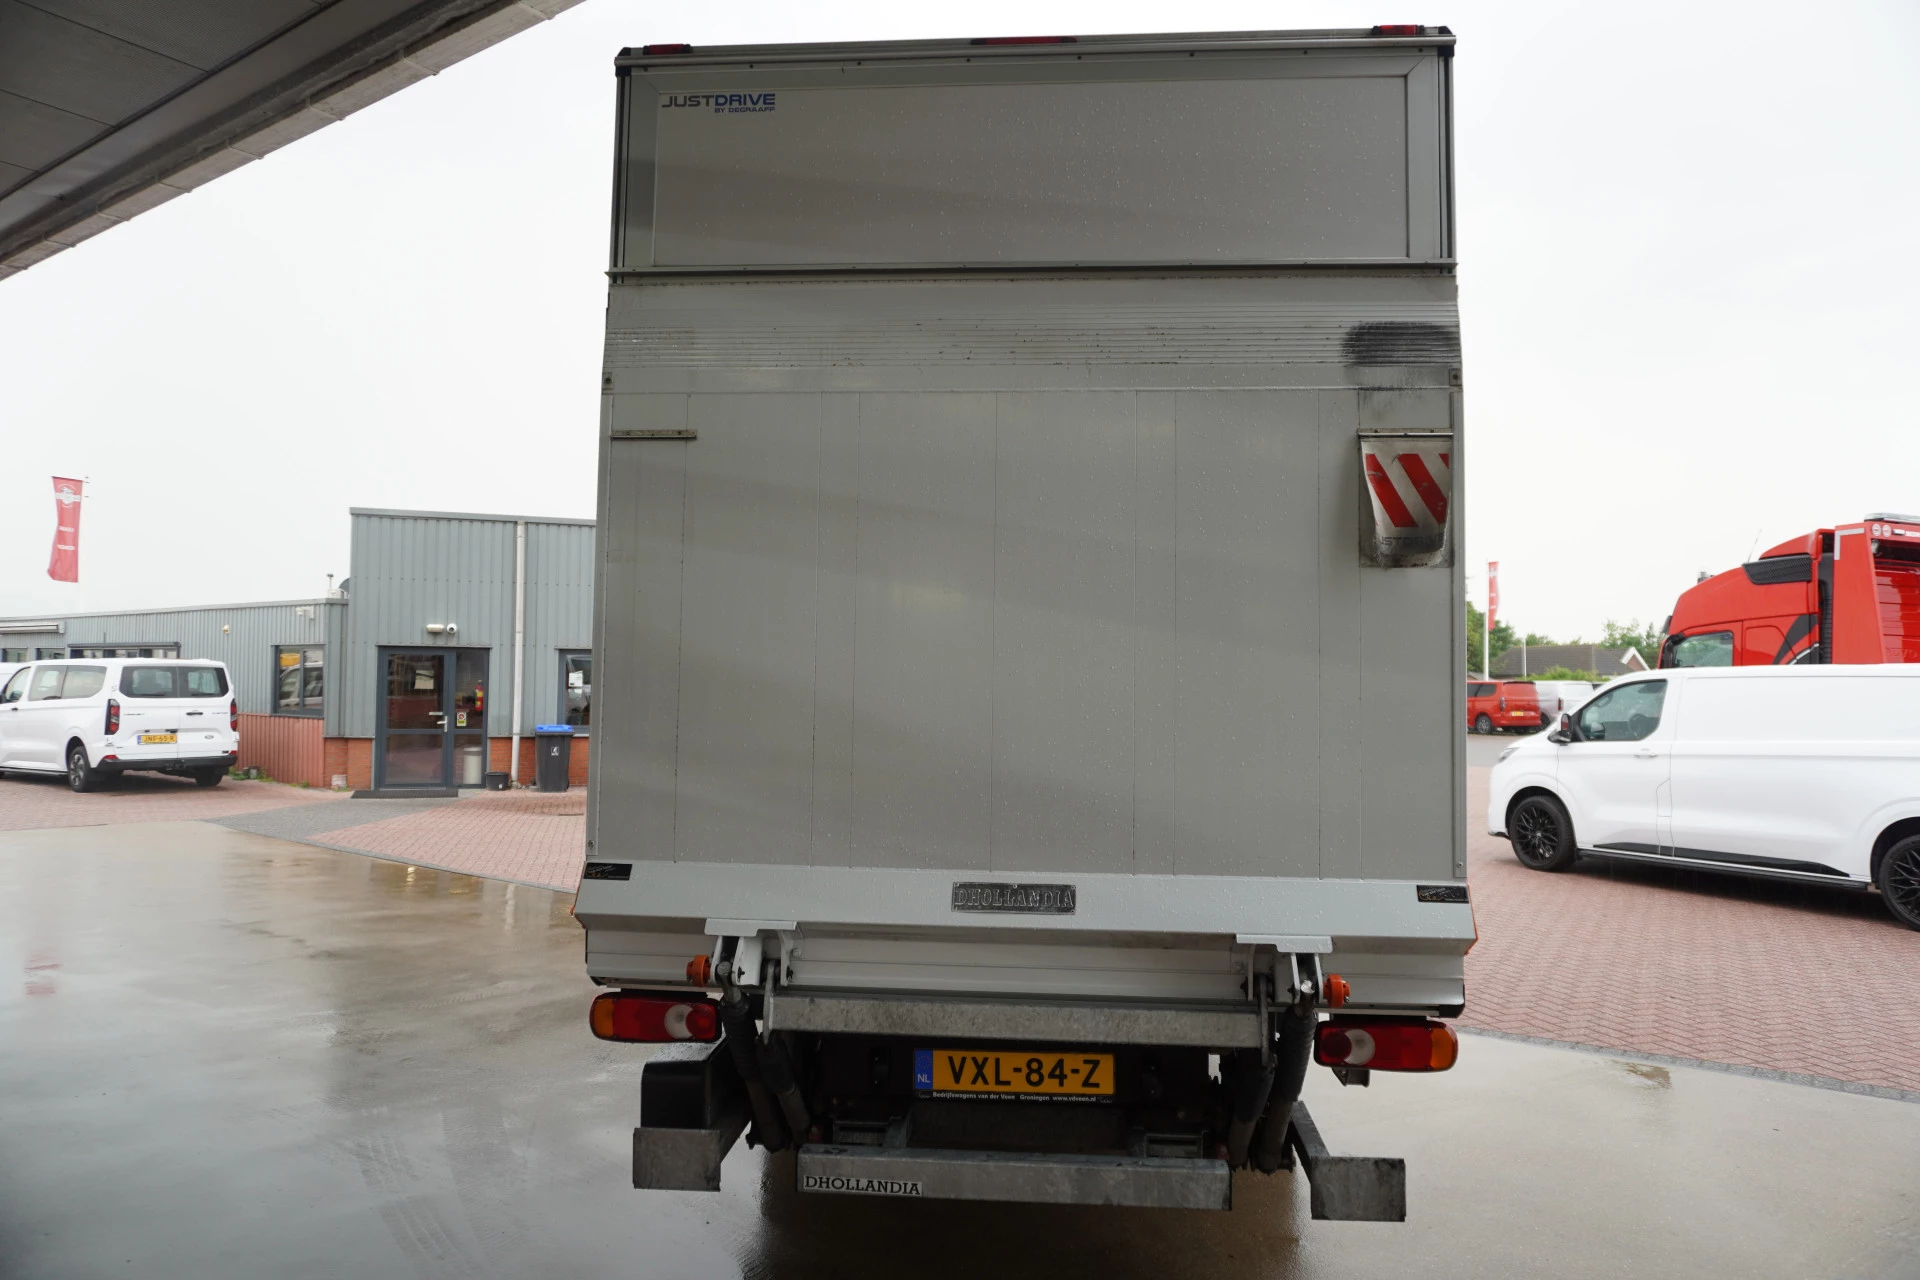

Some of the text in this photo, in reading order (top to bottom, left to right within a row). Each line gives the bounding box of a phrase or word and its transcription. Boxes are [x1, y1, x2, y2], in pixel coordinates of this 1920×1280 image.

[661, 93, 776, 108] JUSTDRIVE
[954, 888, 1074, 908] DHOLLANDIA
[917, 1073, 931, 1084] NL
[947, 1055, 1101, 1089] VXL-84-Z
[932, 1091, 977, 1100] Bedrijfswagens
[1019, 1094, 1050, 1102] Groningen
[1052, 1095, 1097, 1103] www.vdveen.nl
[804, 1176, 921, 1195] DHOLLANDIA
